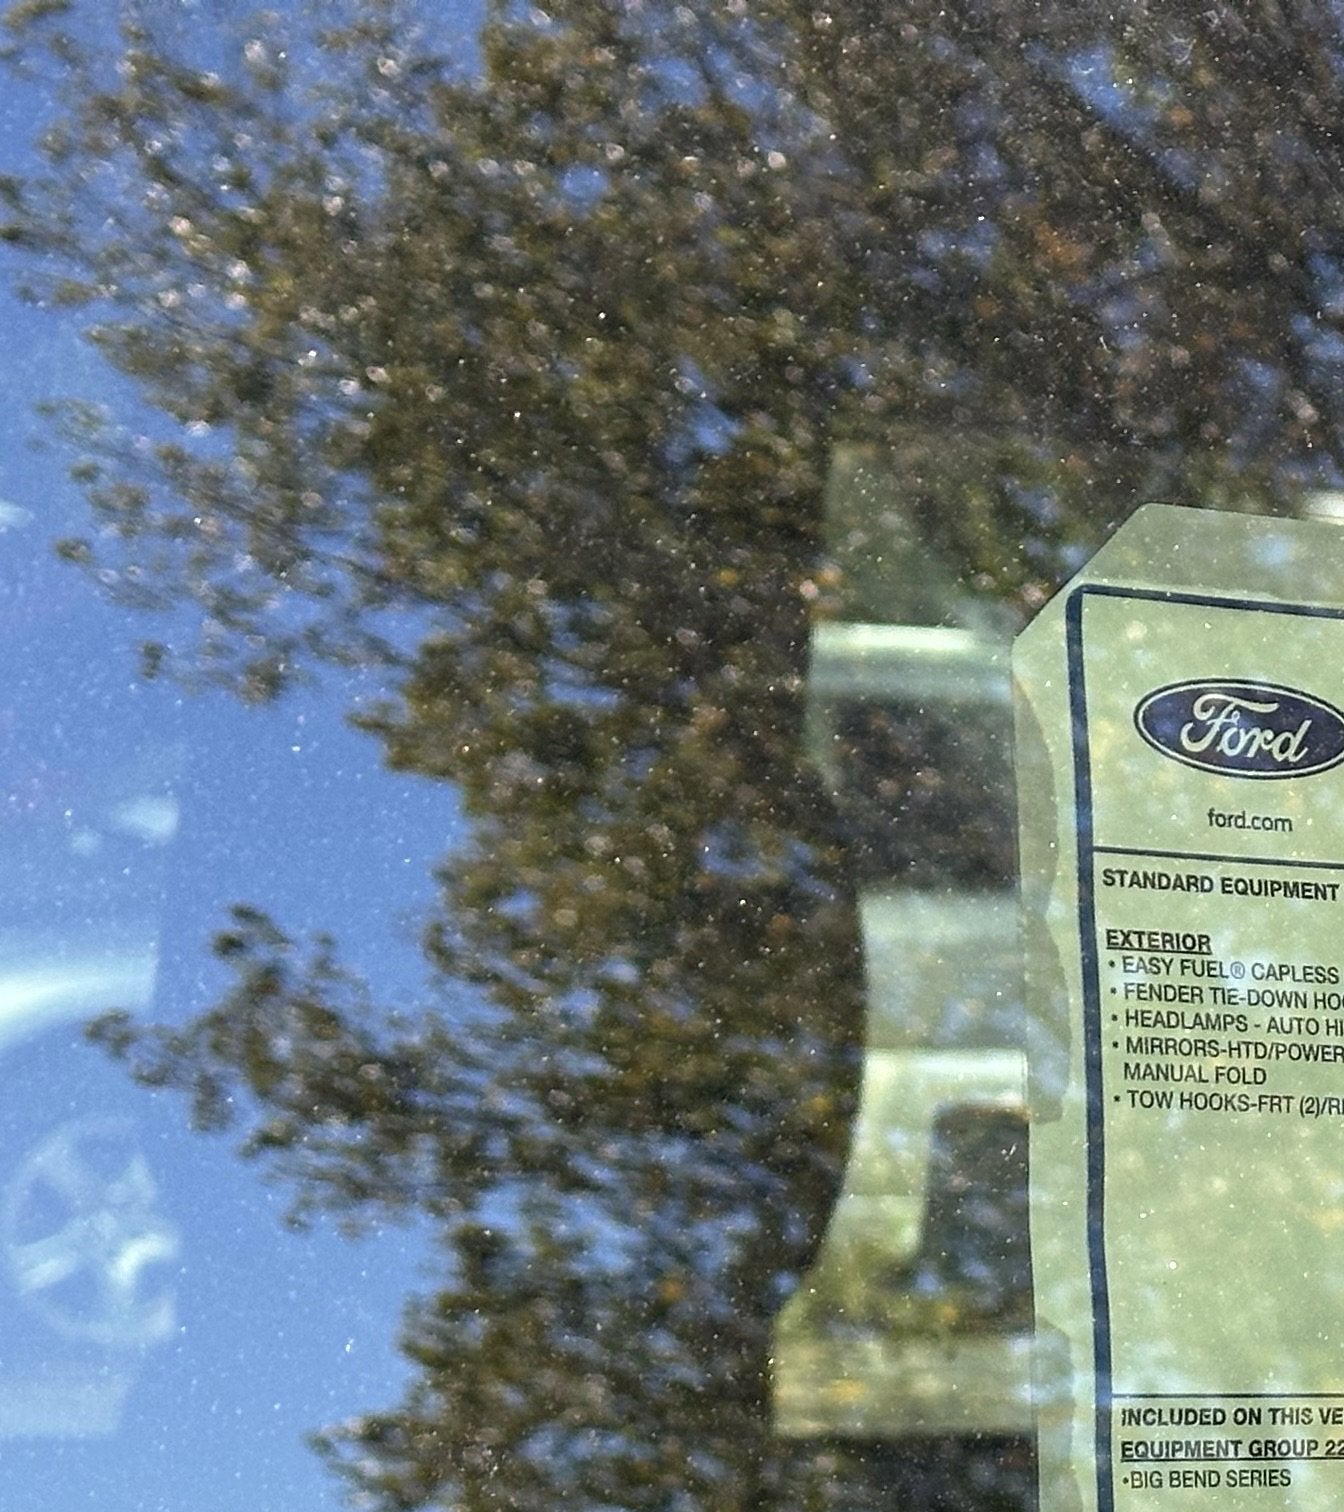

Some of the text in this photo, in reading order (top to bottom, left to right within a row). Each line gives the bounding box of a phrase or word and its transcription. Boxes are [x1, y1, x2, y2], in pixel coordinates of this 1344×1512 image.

[1180, 694, 1309, 762] Ford
[1207, 809, 1292, 832] ford.com
[1102, 869, 1214, 895] STANDARD
[1219, 877, 1340, 903] EQUIPMENT
[1105, 930, 1211, 951] EXTERIOR
[1121, 958, 1173, 976] EASY
[1250, 963, 1340, 983] CAPLESS
[1124, 985, 1204, 1004] FENDER
[1212, 989, 1308, 1009] TIE-DOWN
[1121, 1409, 1227, 1426] INCLUDED
[1232, 1408, 1262, 1425] ON
[1266, 1408, 1313, 1425] THIS
[1120, 1440, 1243, 1457] EQUIPMENT
[1247, 1440, 1319, 1457] GROUP
